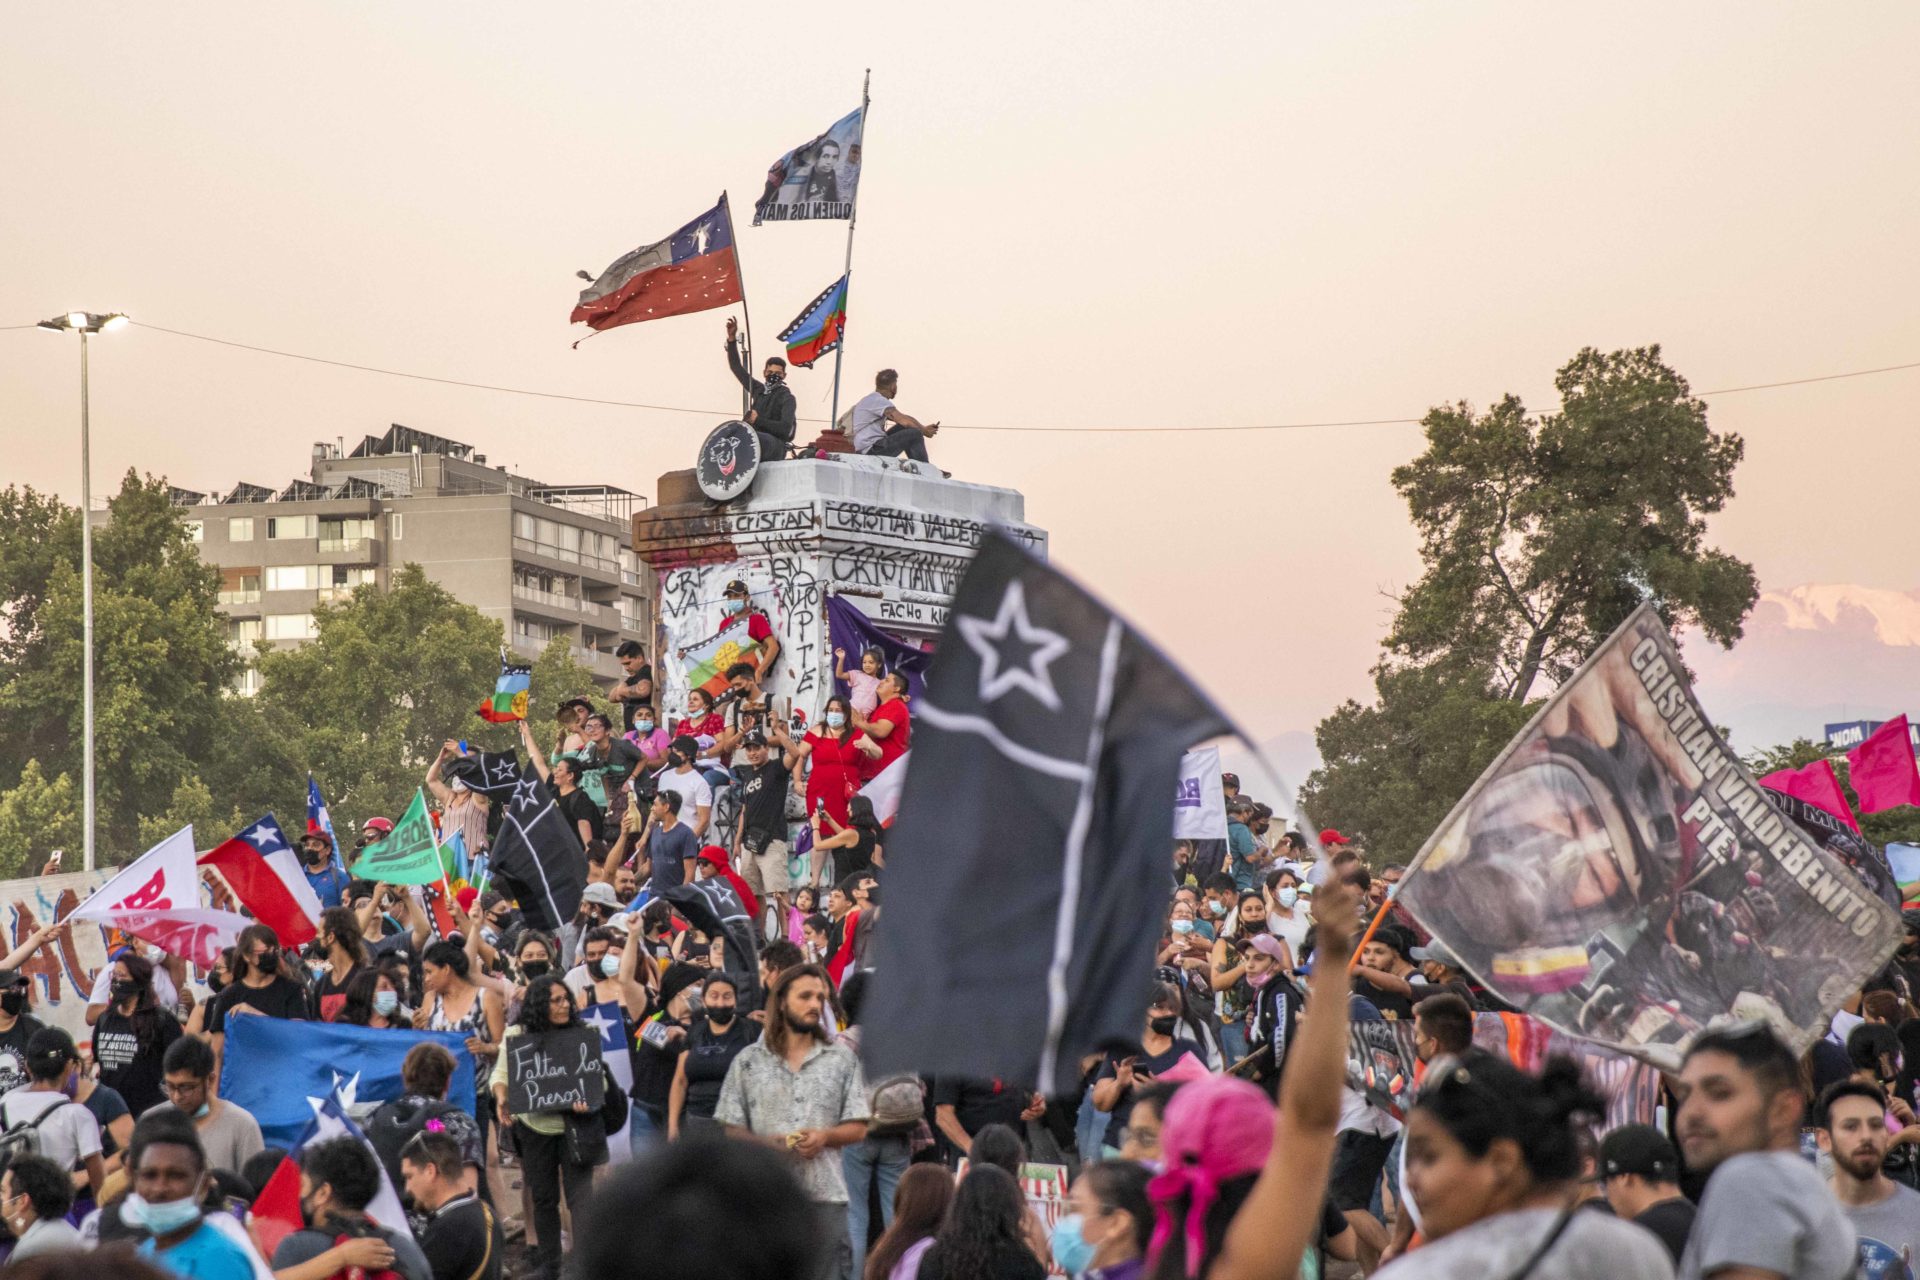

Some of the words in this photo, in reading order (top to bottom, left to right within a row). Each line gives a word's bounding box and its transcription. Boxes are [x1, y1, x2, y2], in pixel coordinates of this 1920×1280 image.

[1629, 636, 1729, 781] CRISTIAN
[1717, 766, 1882, 938] VALDEBENITO
[509, 1043, 567, 1081] Faltan
[575, 1042, 601, 1074] los
[521, 1078, 586, 1110] Presos!
